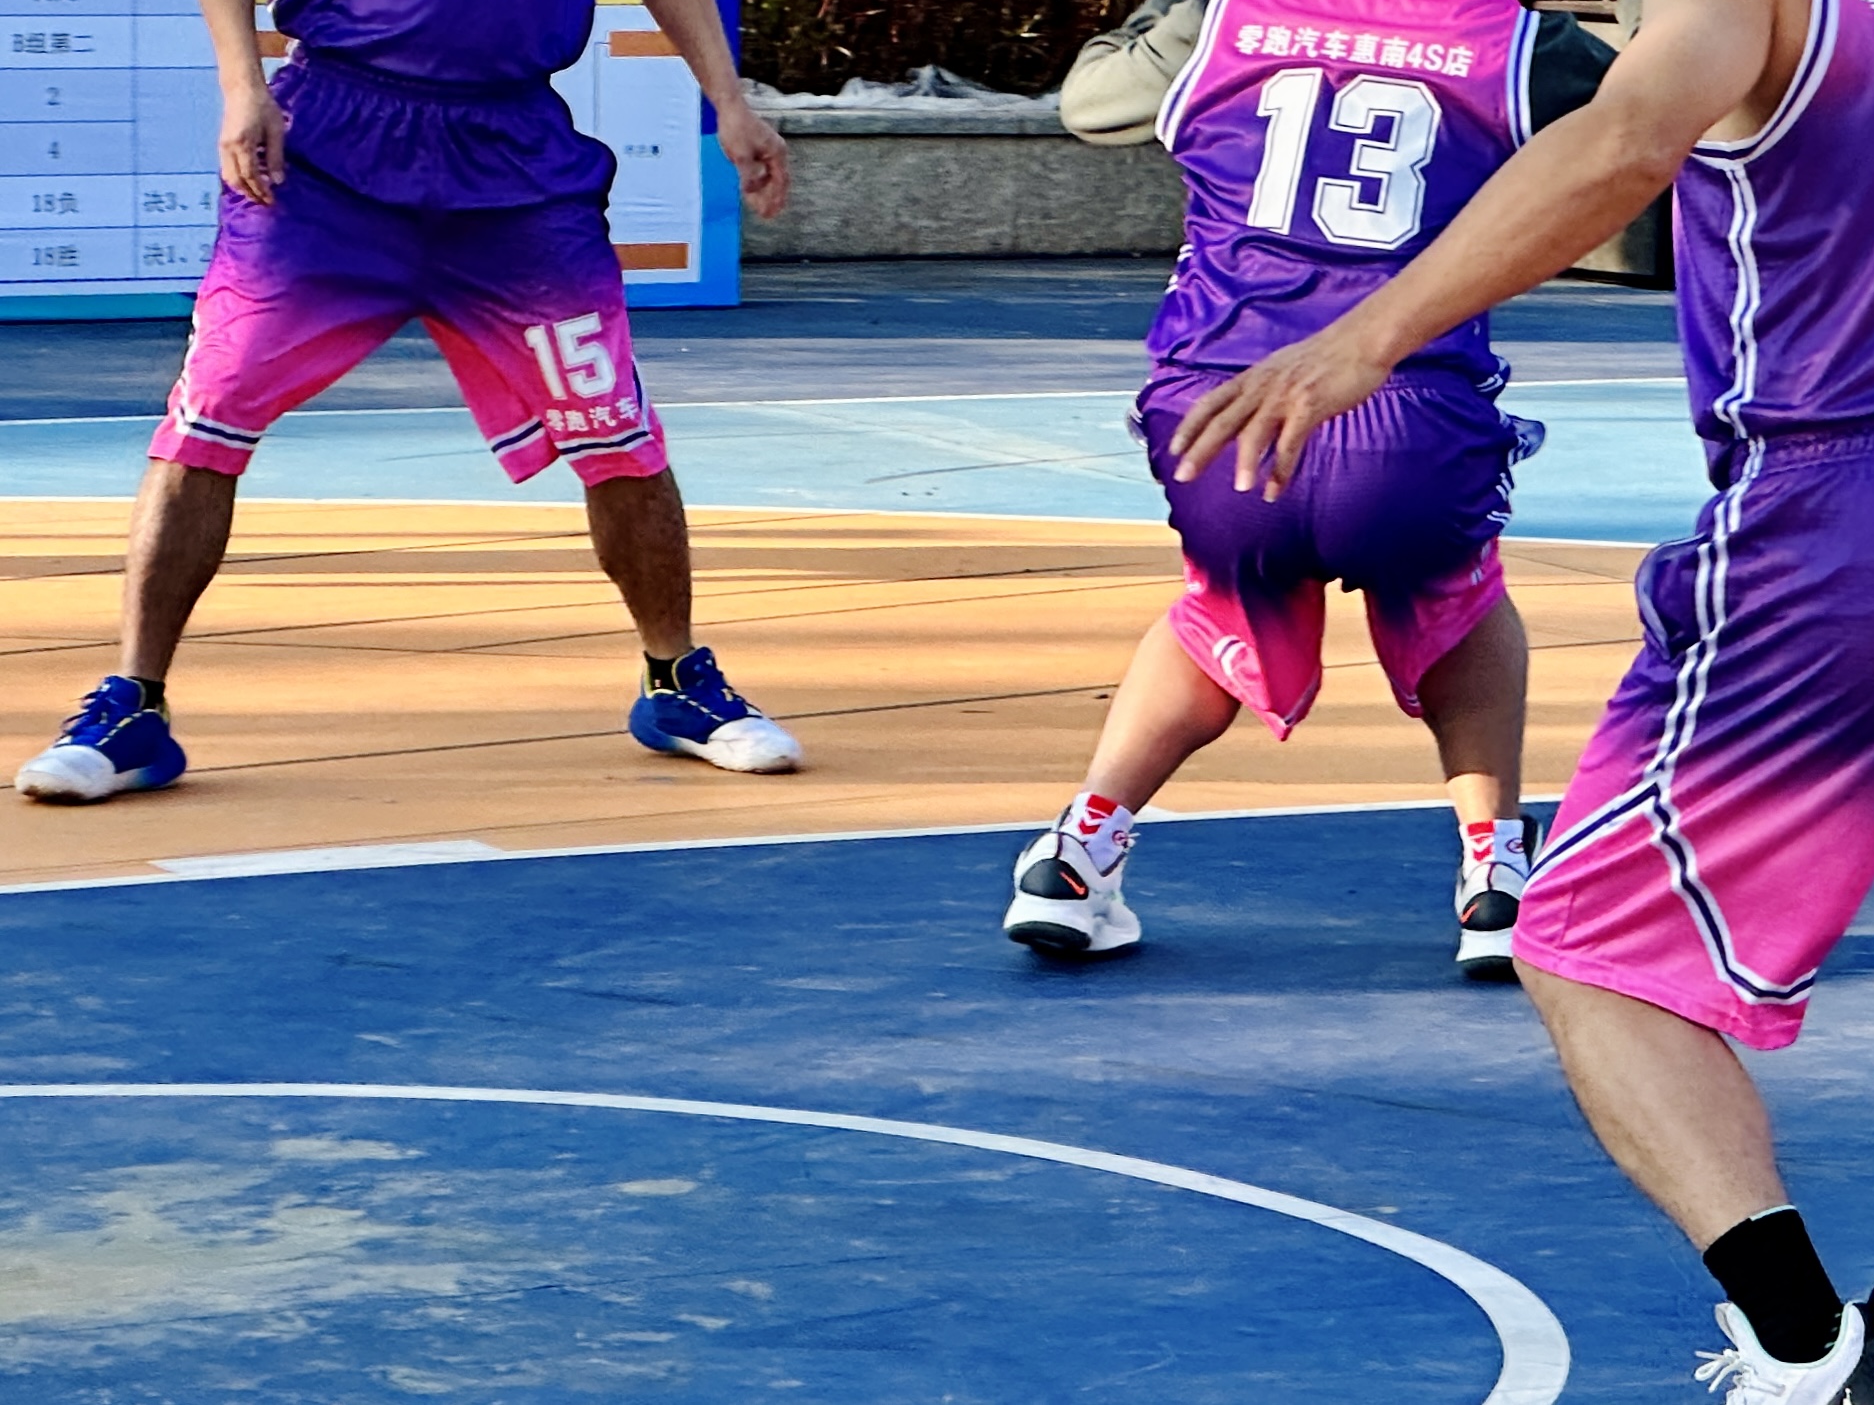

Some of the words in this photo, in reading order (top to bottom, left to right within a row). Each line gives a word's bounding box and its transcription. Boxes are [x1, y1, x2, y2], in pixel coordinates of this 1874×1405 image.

[1235, 24, 1474, 78] 零跑汽车惠南4S店
[46, 87, 60, 106] 2
[1247, 67, 1442, 251] 13
[523, 312, 616, 400] 15
